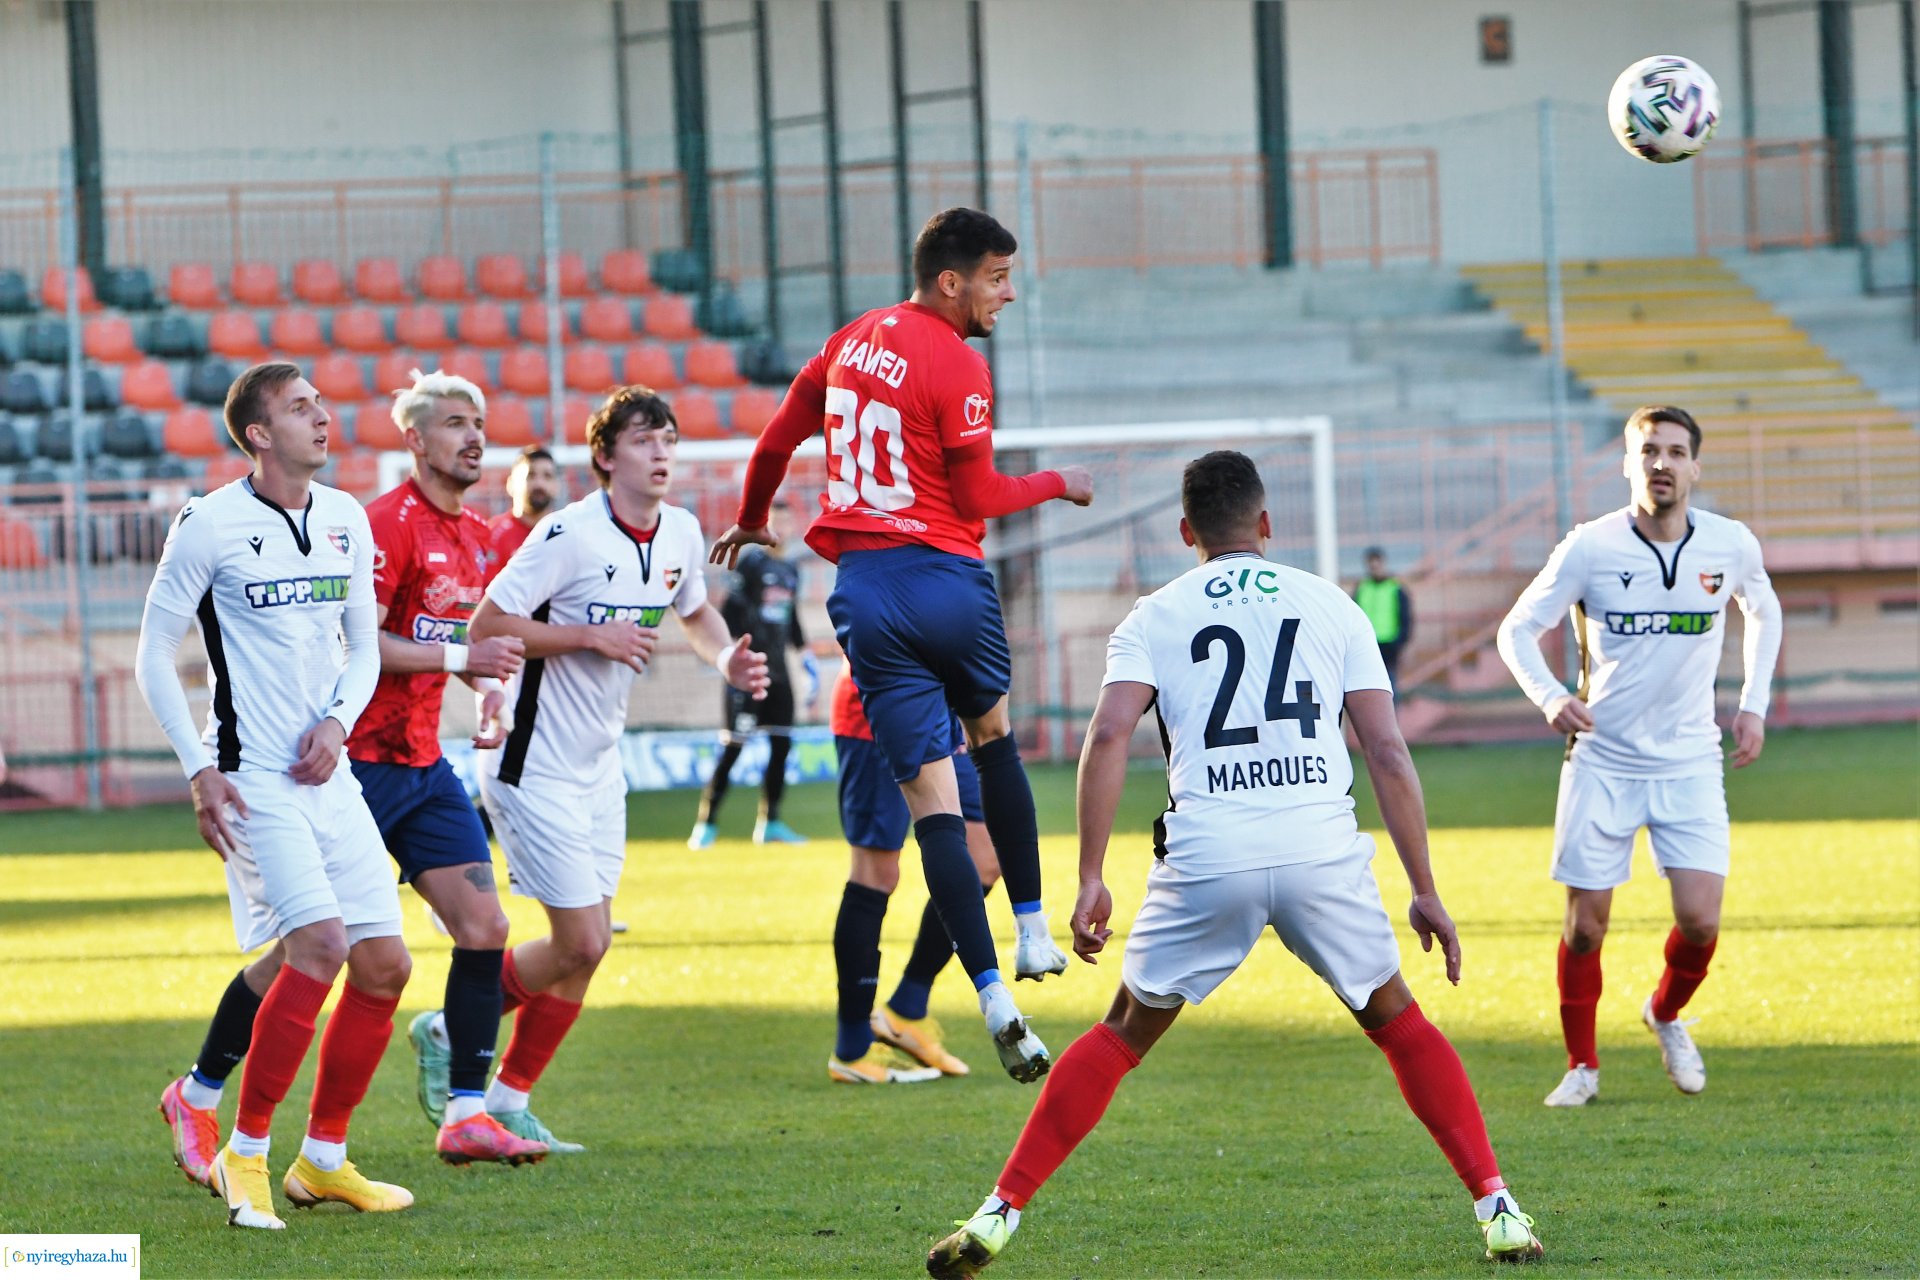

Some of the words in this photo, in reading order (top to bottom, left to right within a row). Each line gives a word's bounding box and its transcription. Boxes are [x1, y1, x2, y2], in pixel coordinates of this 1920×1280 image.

[825, 386, 915, 511] 30
[1205, 569, 1280, 598] GVC
[1212, 596, 1277, 609] GROUP
[1191, 618, 1321, 750] 24
[1207, 755, 1328, 793] MARQUES
